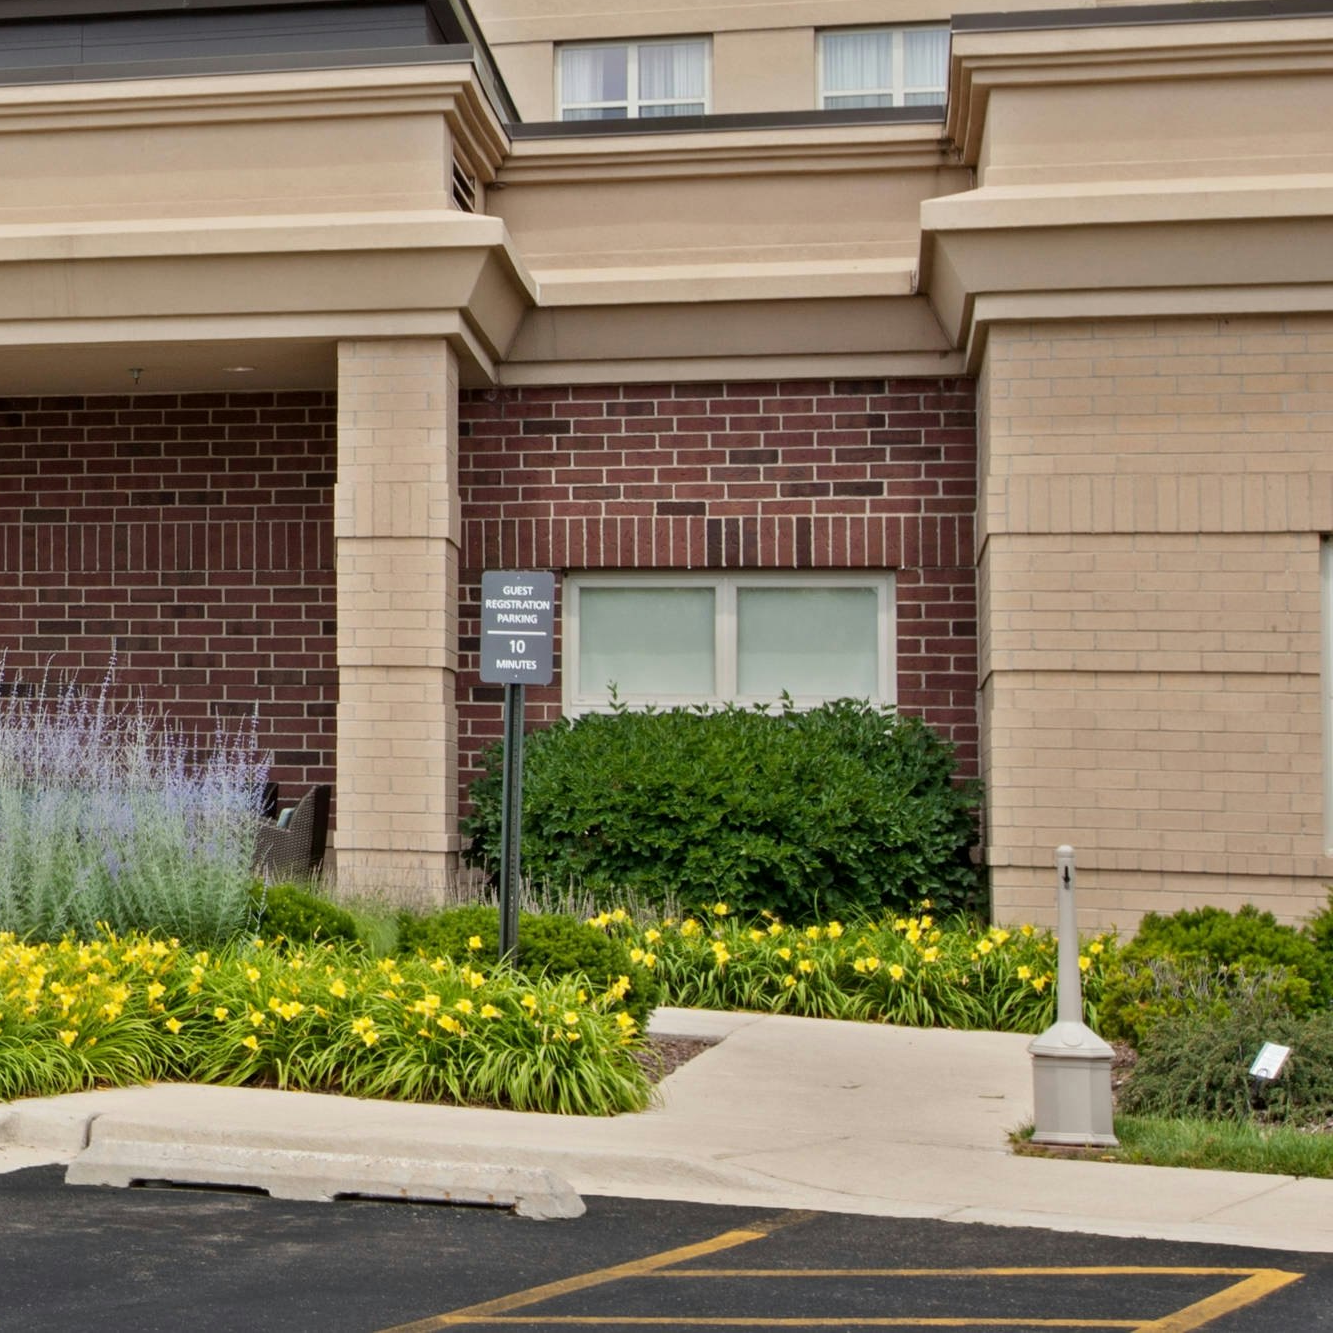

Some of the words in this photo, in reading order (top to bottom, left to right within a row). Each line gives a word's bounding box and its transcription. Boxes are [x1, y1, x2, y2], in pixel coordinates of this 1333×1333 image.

[502, 586, 533, 595] GUEST
[485, 599, 550, 610] REGISTRATION
[497, 613, 538, 624] PARKING
[509, 640, 526, 654] 10
[496, 659, 537, 670] MINUTES
